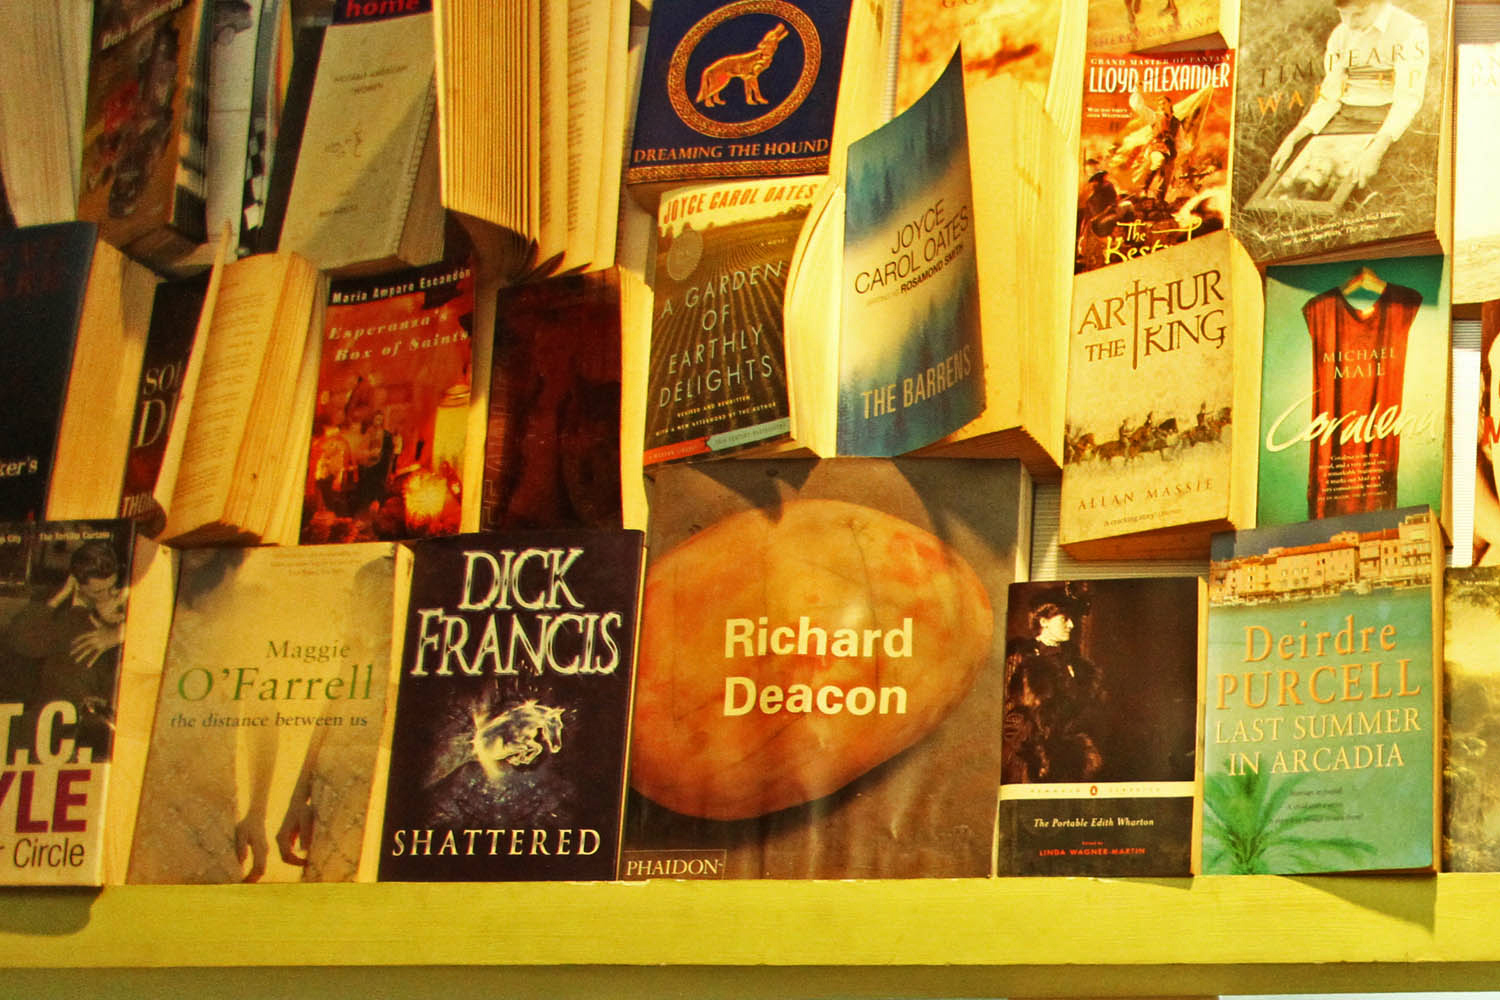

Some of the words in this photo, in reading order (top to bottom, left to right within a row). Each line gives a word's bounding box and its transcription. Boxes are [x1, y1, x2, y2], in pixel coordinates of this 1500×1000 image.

[1089, 66, 1138, 93] LLOYD
[1143, 62, 1231, 93] ALEXANDER
[1091, 56, 1125, 66] GRAND
[1130, 57, 1169, 66] MASTER
[1190, 53, 1231, 63] FANTASY
[1258, 60, 1314, 88] TIM
[1328, 40, 1425, 72] PEARS
[634, 145, 723, 163] DREAMING
[728, 142, 760, 158] THE
[765, 138, 829, 156] HOUND
[663, 194, 704, 225] JOYCE
[709, 189, 757, 210] CAROL
[764, 183, 817, 202] OATES
[891, 199, 945, 254] JOYCE
[854, 254, 920, 294] CAROL
[924, 205, 969, 262] OATES
[901, 258, 944, 294] ROSAMOND
[944, 244, 964, 266] SMITH
[373, 282, 415, 299] Amparo
[661, 299, 673, 319] A
[686, 260, 786, 309] GARDEN
[329, 308, 449, 341] Esperanza's
[702, 309, 731, 332] OF
[1078, 268, 1225, 352] ARTHUR
[381, 340, 402, 357] of
[409, 330, 470, 352] Saints
[668, 324, 764, 375] EARTHLY
[1086, 338, 1126, 362] THE
[1144, 309, 1226, 357] KING
[1323, 345, 1398, 364] MICHAEL
[659, 355, 774, 408] DELIGHTS
[862, 385, 897, 420] THE
[901, 344, 973, 409] BARRENS
[1333, 361, 1386, 380] MAIL
[1266, 388, 1439, 453] Coralena
[1078, 491, 1134, 511] ALLAN
[1145, 478, 1213, 499] MASSIE
[457, 545, 585, 612] DICK
[266, 639, 352, 664] Maggie
[410, 606, 624, 678] FRANCIS
[725, 616, 914, 659] Richard
[1243, 613, 1398, 663] Deirdre
[178, 663, 374, 703] O'Farrell
[723, 675, 908, 717] Deacon
[1215, 657, 1423, 711] PURCELL
[170, 713, 196, 728] the
[201, 712, 270, 729] distance
[274, 712, 344, 728] between
[350, 714, 368, 727] us
[1215, 716, 1285, 745] LAST
[1293, 707, 1422, 740] SUMMER
[1228, 750, 1263, 778] IN
[1271, 741, 1407, 775] ARCADIA
[1034, 818, 1049, 828] The
[1052, 817, 1088, 828] Portable
[1091, 817, 1114, 827] Edith
[1117, 816, 1155, 827] Wharton
[13, 837, 86, 869] Circle
[391, 828, 601, 857] SHATTERED
[1039, 848, 1066, 857] LINDA
[1069, 847, 1147, 857] WAGNER-MARTIN
[626, 859, 719, 877] PHAIDON
